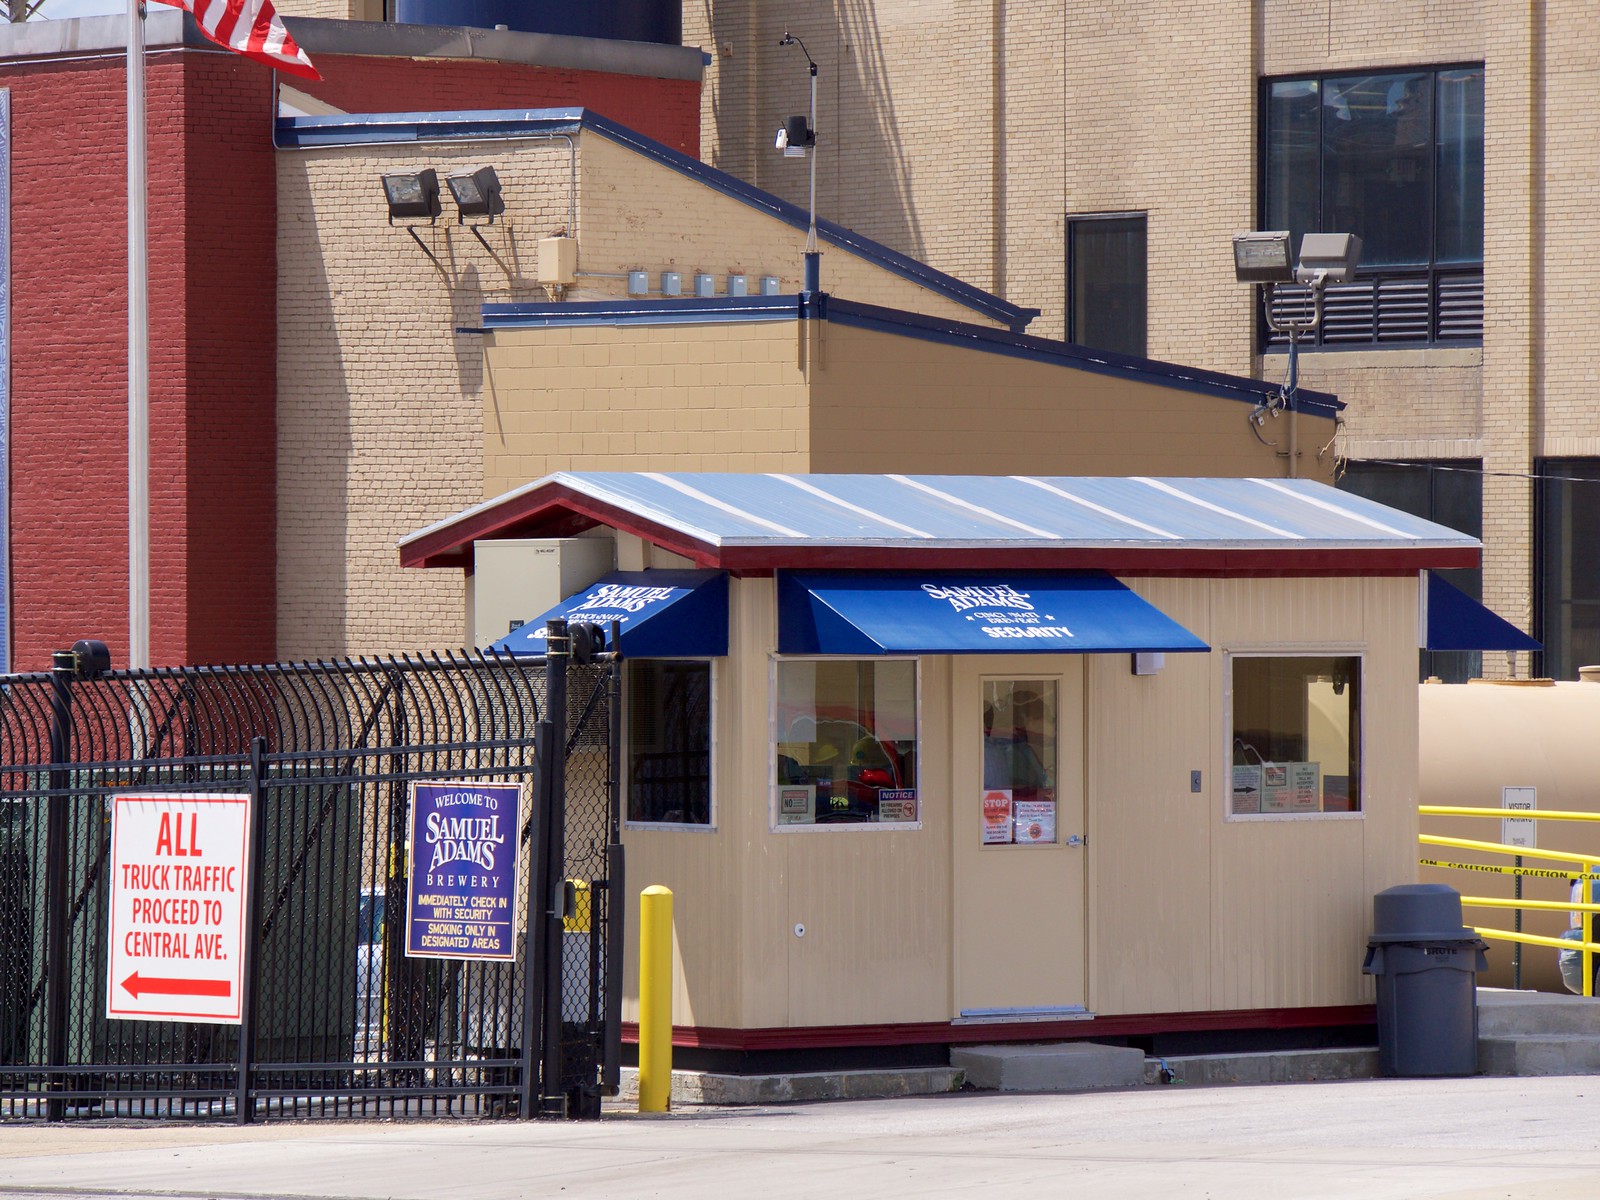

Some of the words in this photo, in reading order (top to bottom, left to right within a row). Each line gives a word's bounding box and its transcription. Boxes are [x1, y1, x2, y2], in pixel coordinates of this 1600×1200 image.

[587, 584, 678, 600] SAMUEL
[920, 583, 1031, 599] SAMUEL
[566, 597, 657, 613] ADAMS
[948, 596, 1035, 613] ADAMS
[981, 626, 1074, 638] SECURITY
[435, 792, 483, 809] WELCOME
[484, 795, 498, 811] TO
[882, 791, 914, 799] NOTICE
[984, 799, 1008, 808] STOP
[1508, 802, 1531, 810] VISITOR
[155, 812, 203, 857] ALL
[425, 812, 504, 844] SAMUEL
[428, 840, 496, 873] ADAMS
[121, 864, 170, 890] TRUCK
[173, 865, 236, 893] TRAFFIC
[1448, 862, 1503, 873] CAUTION
[1513, 868, 1568, 879] CAUTION
[426, 873, 500, 889] BREWERY
[418, 894, 469, 907] IMMEDIATELY
[470, 896, 497, 908] CHECK
[498, 898, 507, 908] IN
[132, 898, 200, 926] PROCEED
[203, 900, 222, 926] TO
[433, 907, 451, 919] WITH
[454, 908, 493, 920] SECURITY
[428, 923, 463, 936] SMOKING
[464, 925, 486, 937] ONLY
[487, 926, 496, 937] IN
[124, 931, 190, 959] CENTRAL
[194, 933, 228, 960] AVE.
[421, 935, 470, 949] DESIGNATED
[471, 937, 500, 950] AREAS
